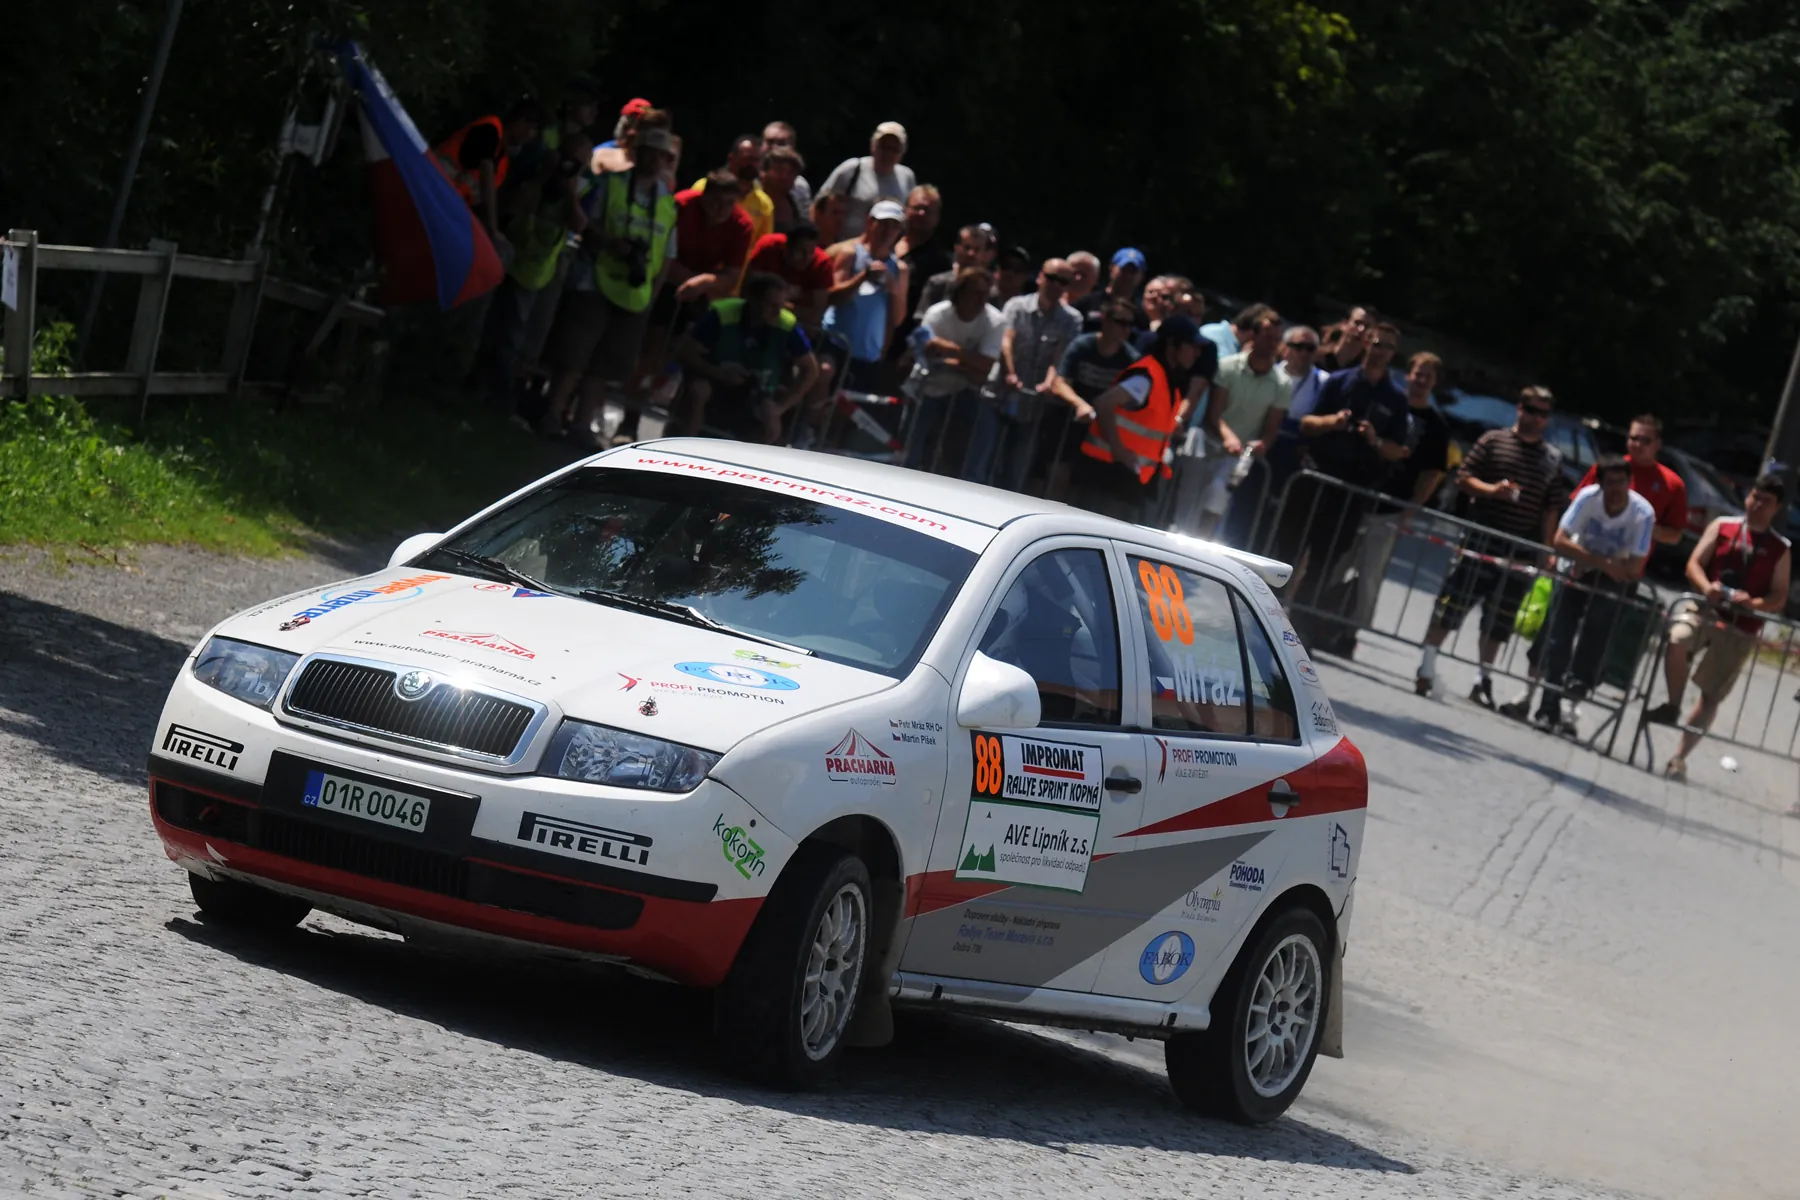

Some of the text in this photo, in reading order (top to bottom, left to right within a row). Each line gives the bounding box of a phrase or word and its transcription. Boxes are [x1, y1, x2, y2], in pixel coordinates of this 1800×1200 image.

[638, 457, 948, 532] www.petrmraz.com
[1138, 560, 1195, 646] 88
[423, 630, 536, 660] PRACHARNA
[354, 639, 543, 687] www.autobazar-pracharna.cz
[651, 681, 693, 691] PROFI
[697, 687, 785, 705] PROMOTION
[162, 723, 245, 771] PIRELLI
[901, 733, 920, 744] Martin
[825, 758, 896, 776] PRACHARNA
[975, 734, 1002, 795] 88
[1021, 743, 1085, 772] IMPROMAT
[1172, 749, 1237, 767] PROFI PROMOTION
[303, 793, 317, 806] CZ
[1006, 774, 1100, 805] RALLYE SPRINT KOPNÁ
[517, 811, 653, 866] PIRELLI
[1003, 823, 1089, 856] AVE Lipník z.s.
[999, 852, 1031, 866] společnost
[1031, 857, 1041, 868] pro
[1229, 864, 1264, 884] POHODA
[1185, 890, 1221, 914] Olympia
[1142, 951, 1194, 966] FABOK
